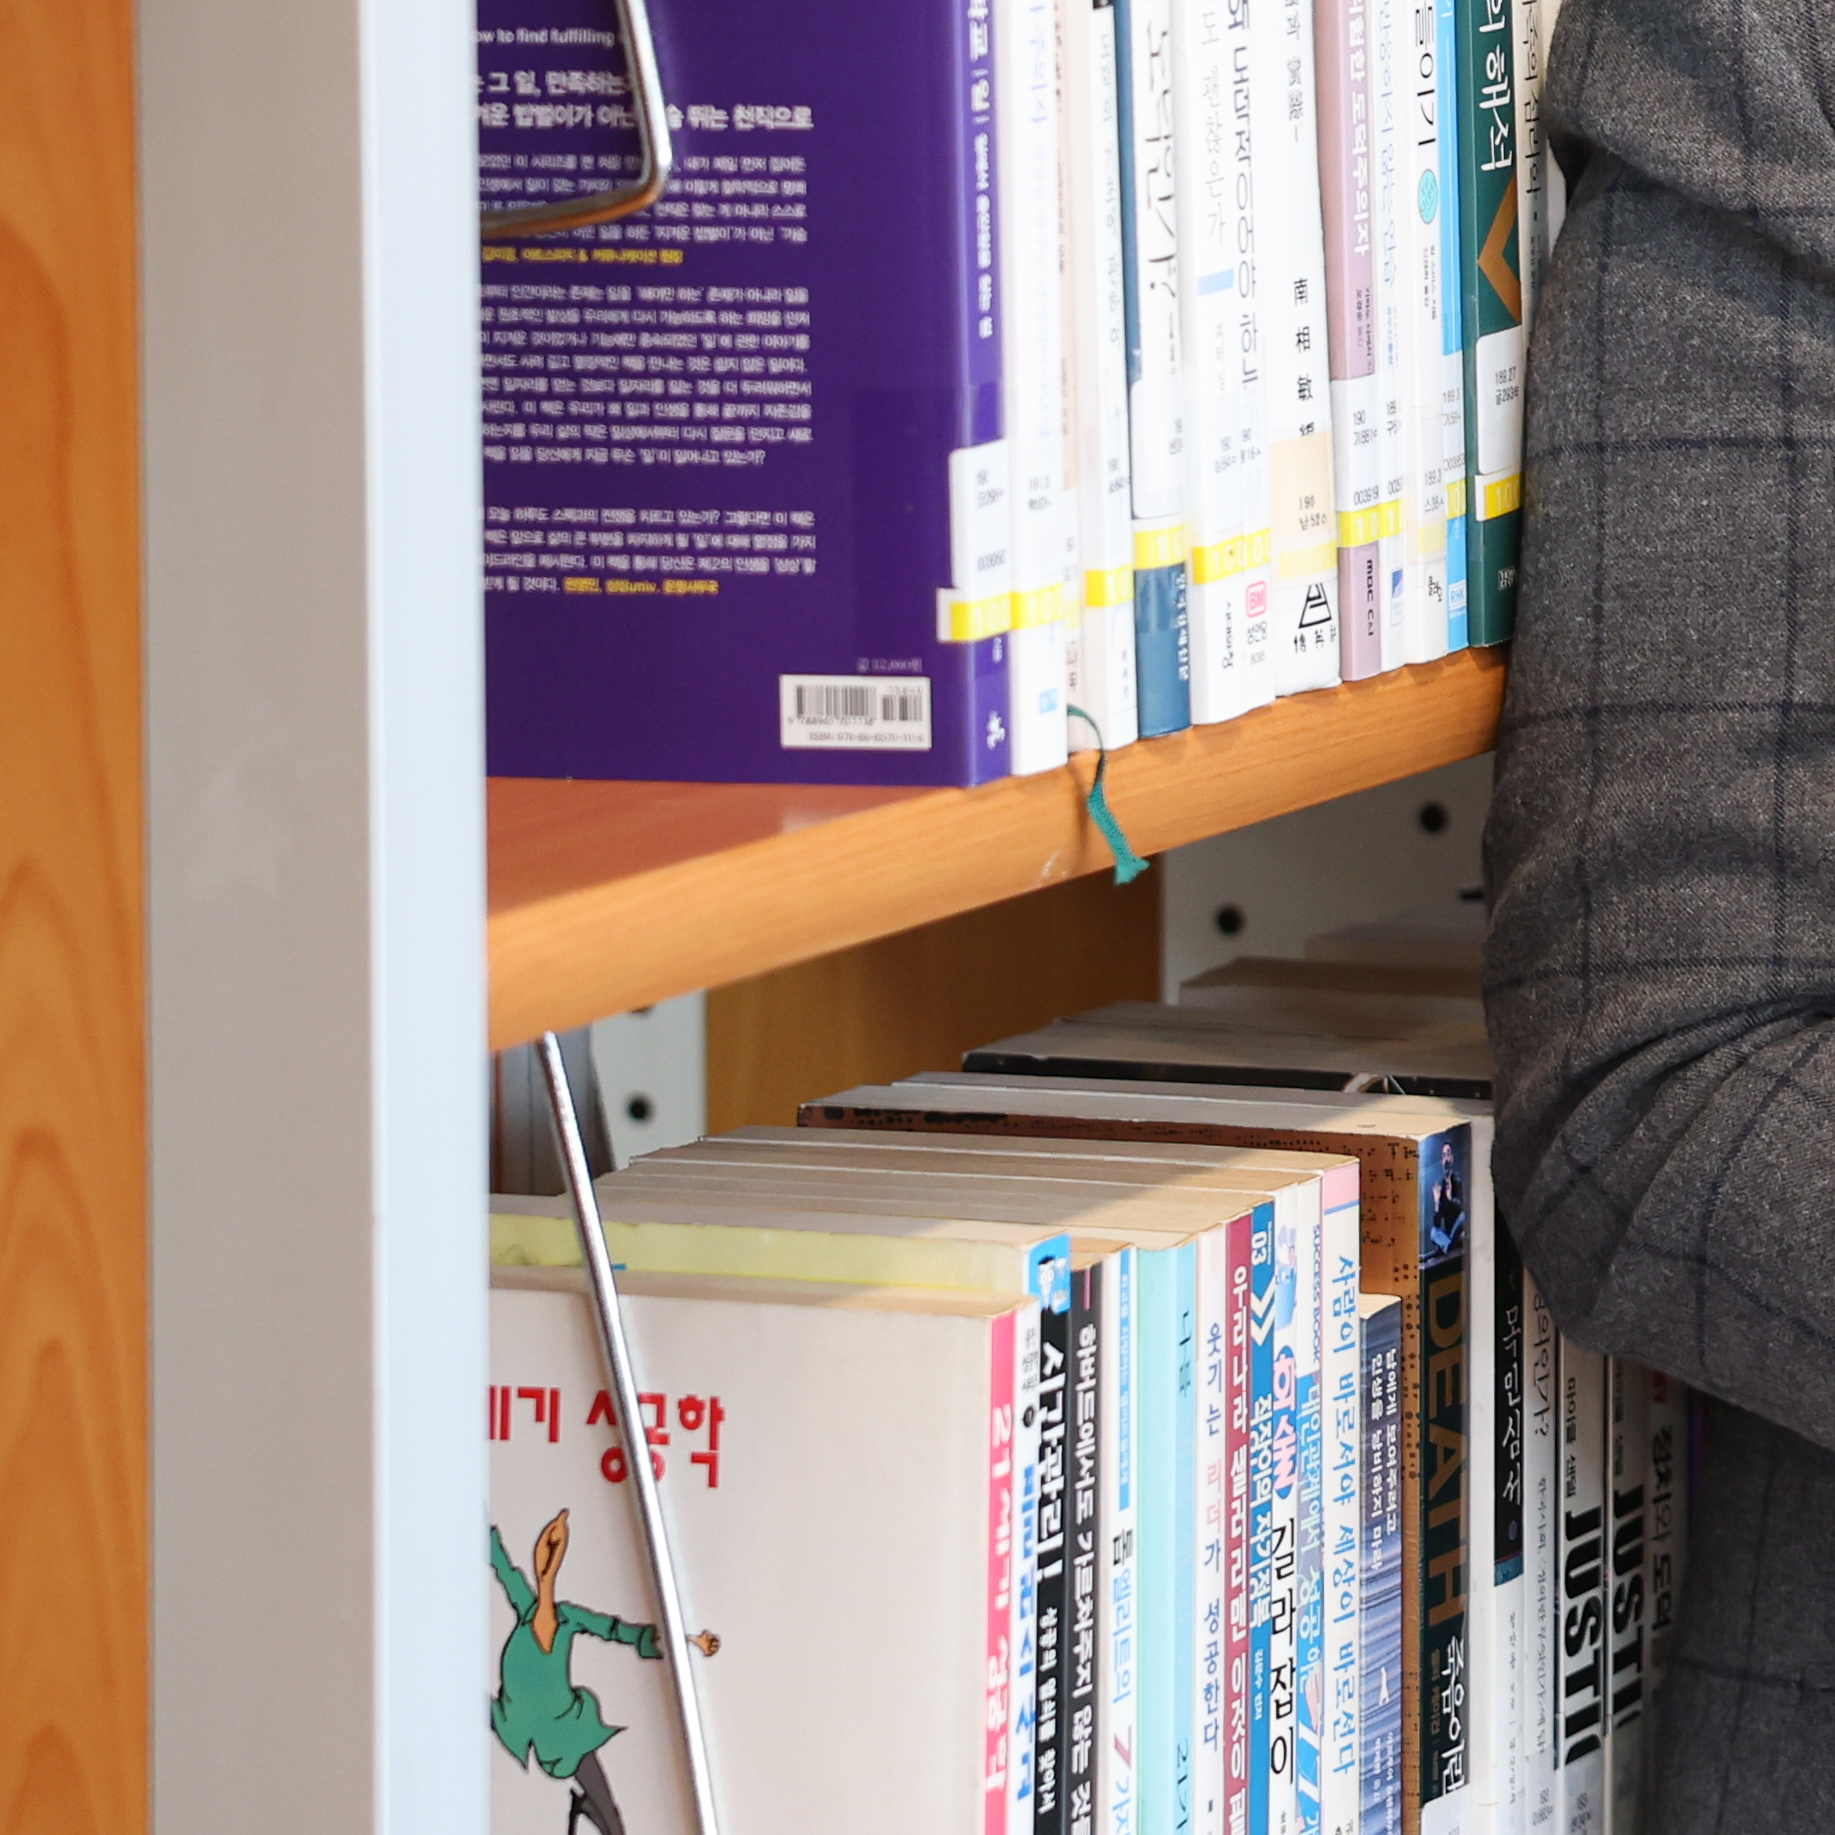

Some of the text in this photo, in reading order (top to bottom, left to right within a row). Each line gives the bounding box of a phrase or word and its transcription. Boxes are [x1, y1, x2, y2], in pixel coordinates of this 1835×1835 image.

[1478, 43, 1512, 175] 해석
[1252, 1230, 1267, 1266] 03
[1035, 1343, 1066, 1582] 시간관리!
[1071, 1324, 1098, 1776] 하버드에서도 가르쳐주지 않는
[1229, 1264, 1248, 1781] 우리나라 샐러리맨 이것이
[1332, 1254, 1357, 1775] 사람이 바로서야 세상이 바로선다
[1429, 1269, 1467, 1628] DEATH
[1202, 1596, 1220, 1754] 성공한다
[1270, 1516, 1295, 1786] 길라잡이
[1613, 1483, 1644, 1730] JUSTI
